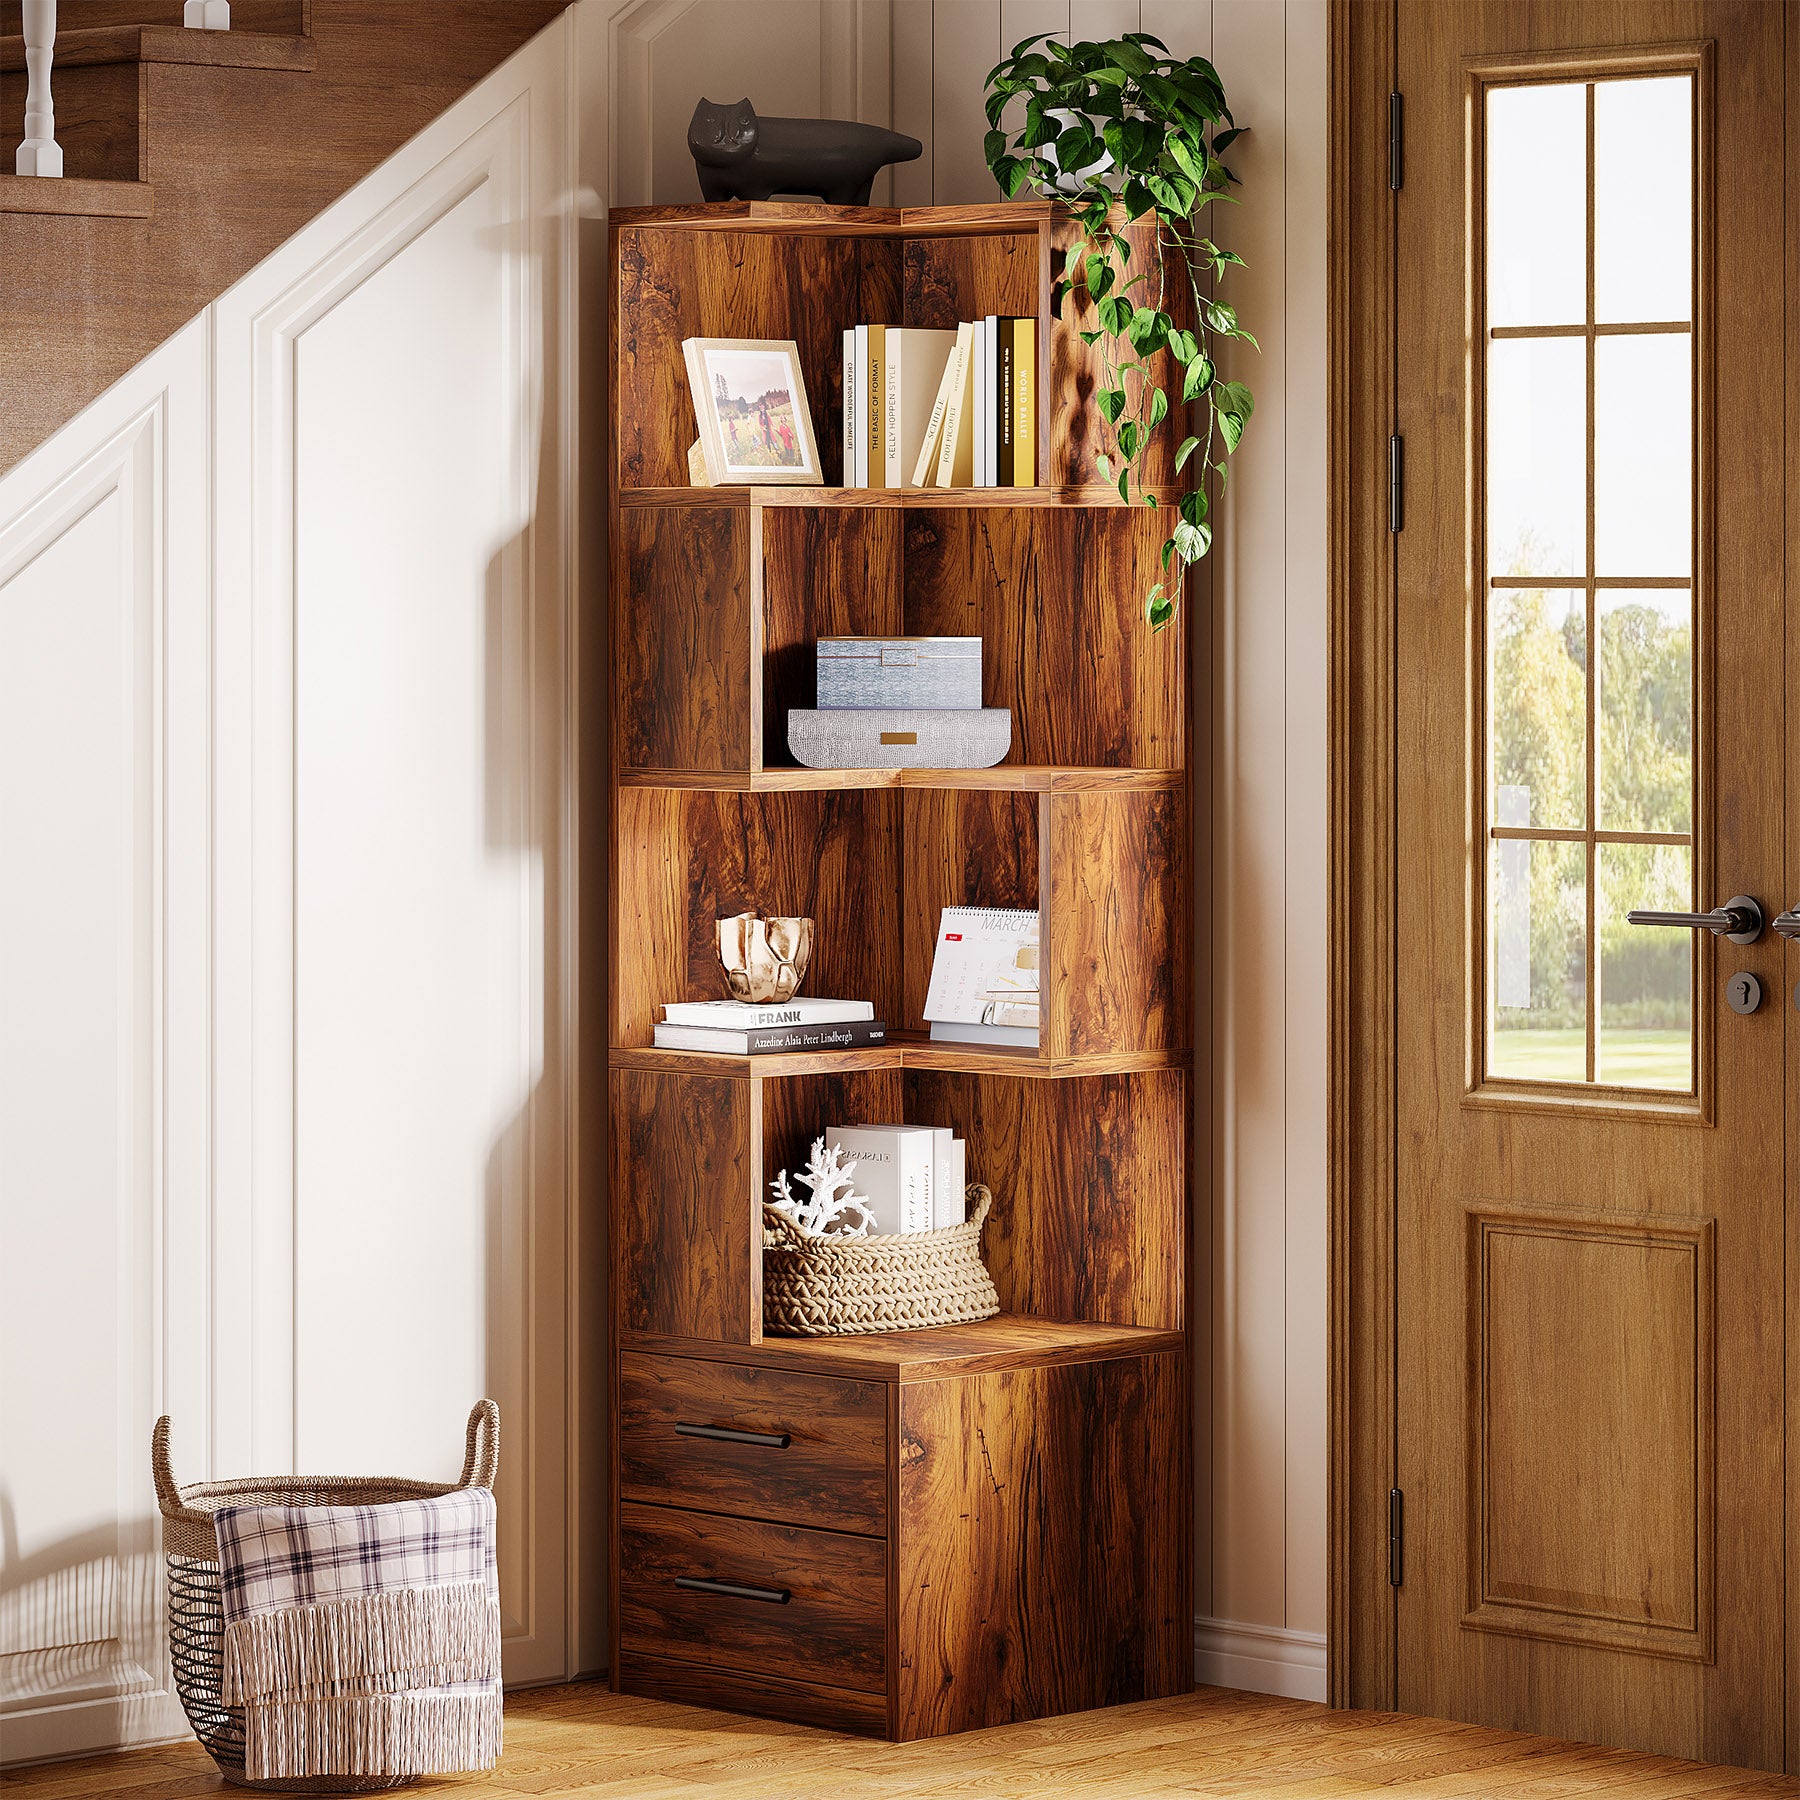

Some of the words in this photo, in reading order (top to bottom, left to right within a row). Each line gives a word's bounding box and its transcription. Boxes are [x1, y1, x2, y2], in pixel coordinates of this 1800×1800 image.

[888, 364, 896, 391] STYLE
[1019, 369, 1027, 404] WORLD
[872, 395, 879, 407] OF
[888, 393, 896, 429] HOPPEN
[1019, 406, 1027, 439] BALLET
[888, 431, 896, 459] KELLY
[943, 442, 952, 463] JODI
[981, 917, 1031, 933] MARCH
[758, 1010, 802, 1025] FRANK
[755, 1035, 784, 1048] Azzedine
[803, 1032, 819, 1045] Peter
[820, 1029, 853, 1045] Lindbergh
